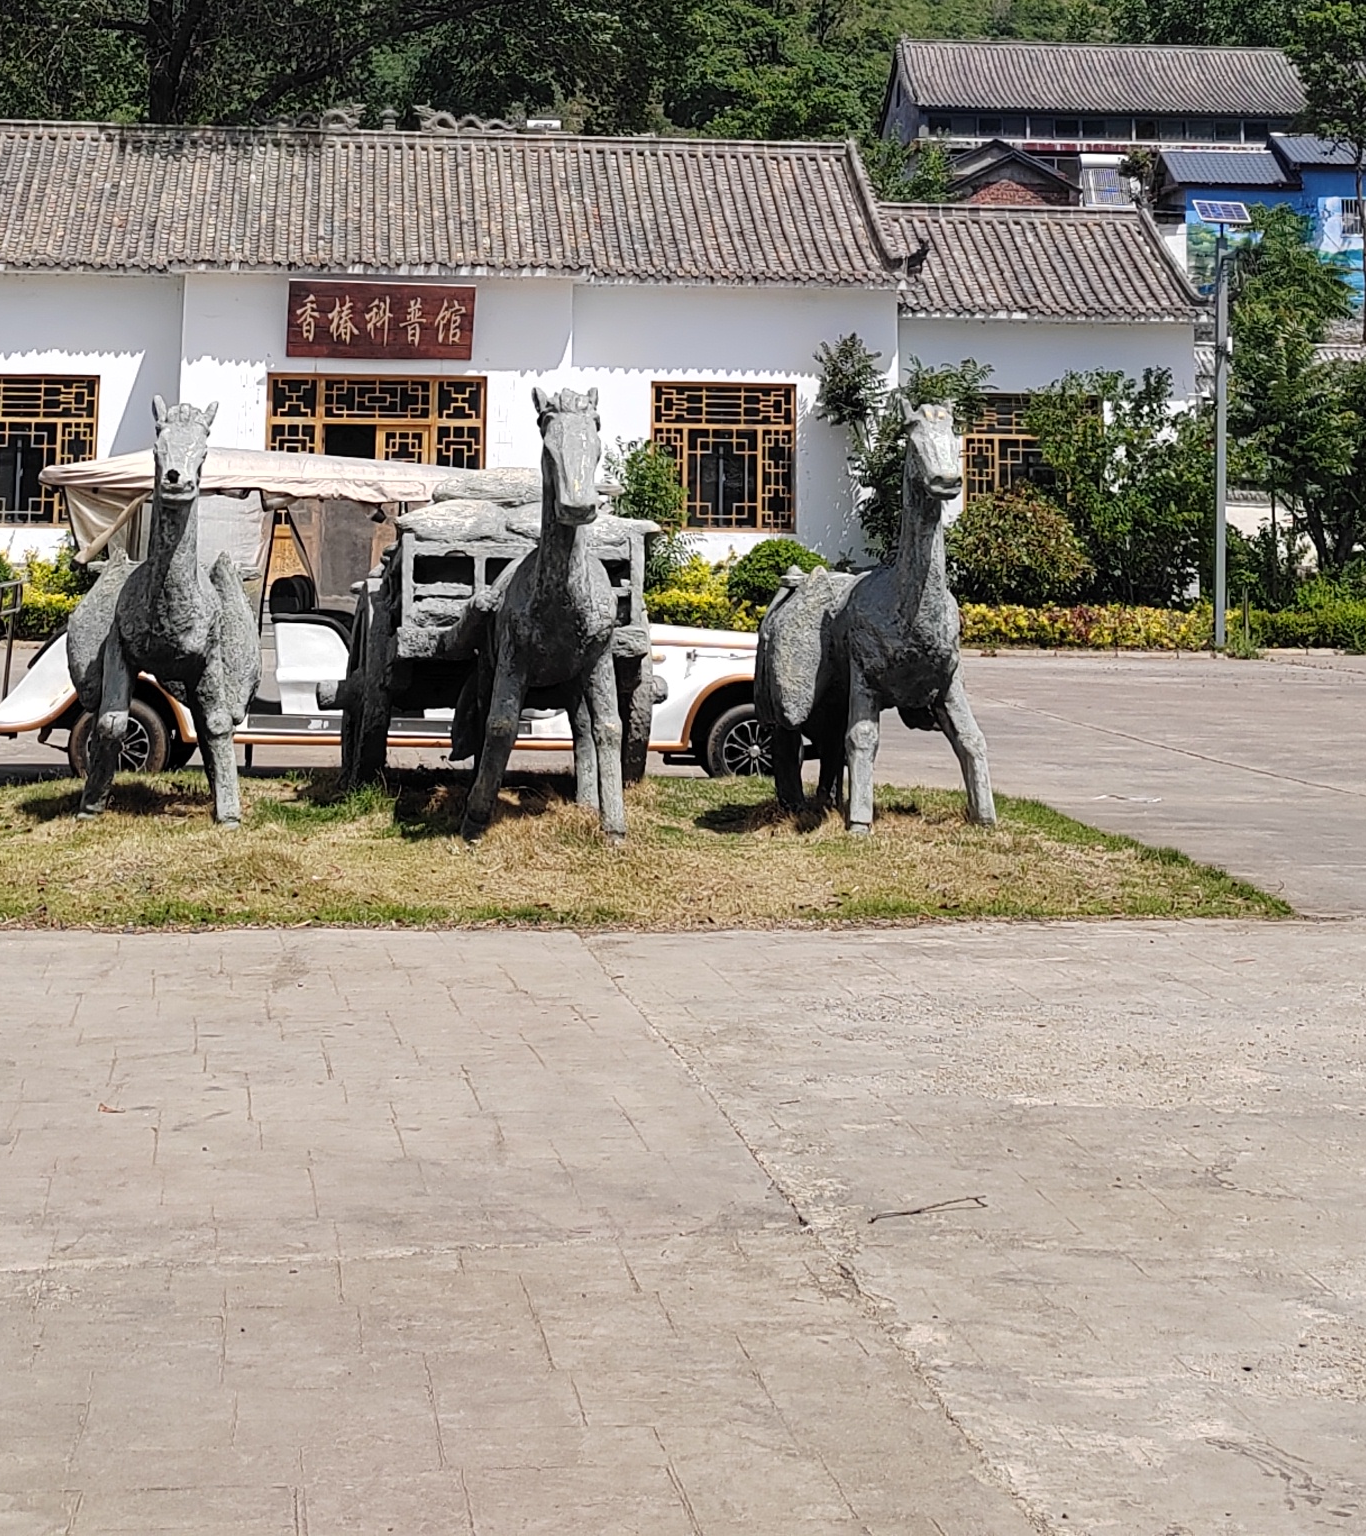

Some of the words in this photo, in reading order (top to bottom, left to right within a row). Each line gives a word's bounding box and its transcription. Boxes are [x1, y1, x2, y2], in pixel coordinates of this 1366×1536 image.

[296, 293, 467, 347] 香椿科普馆
